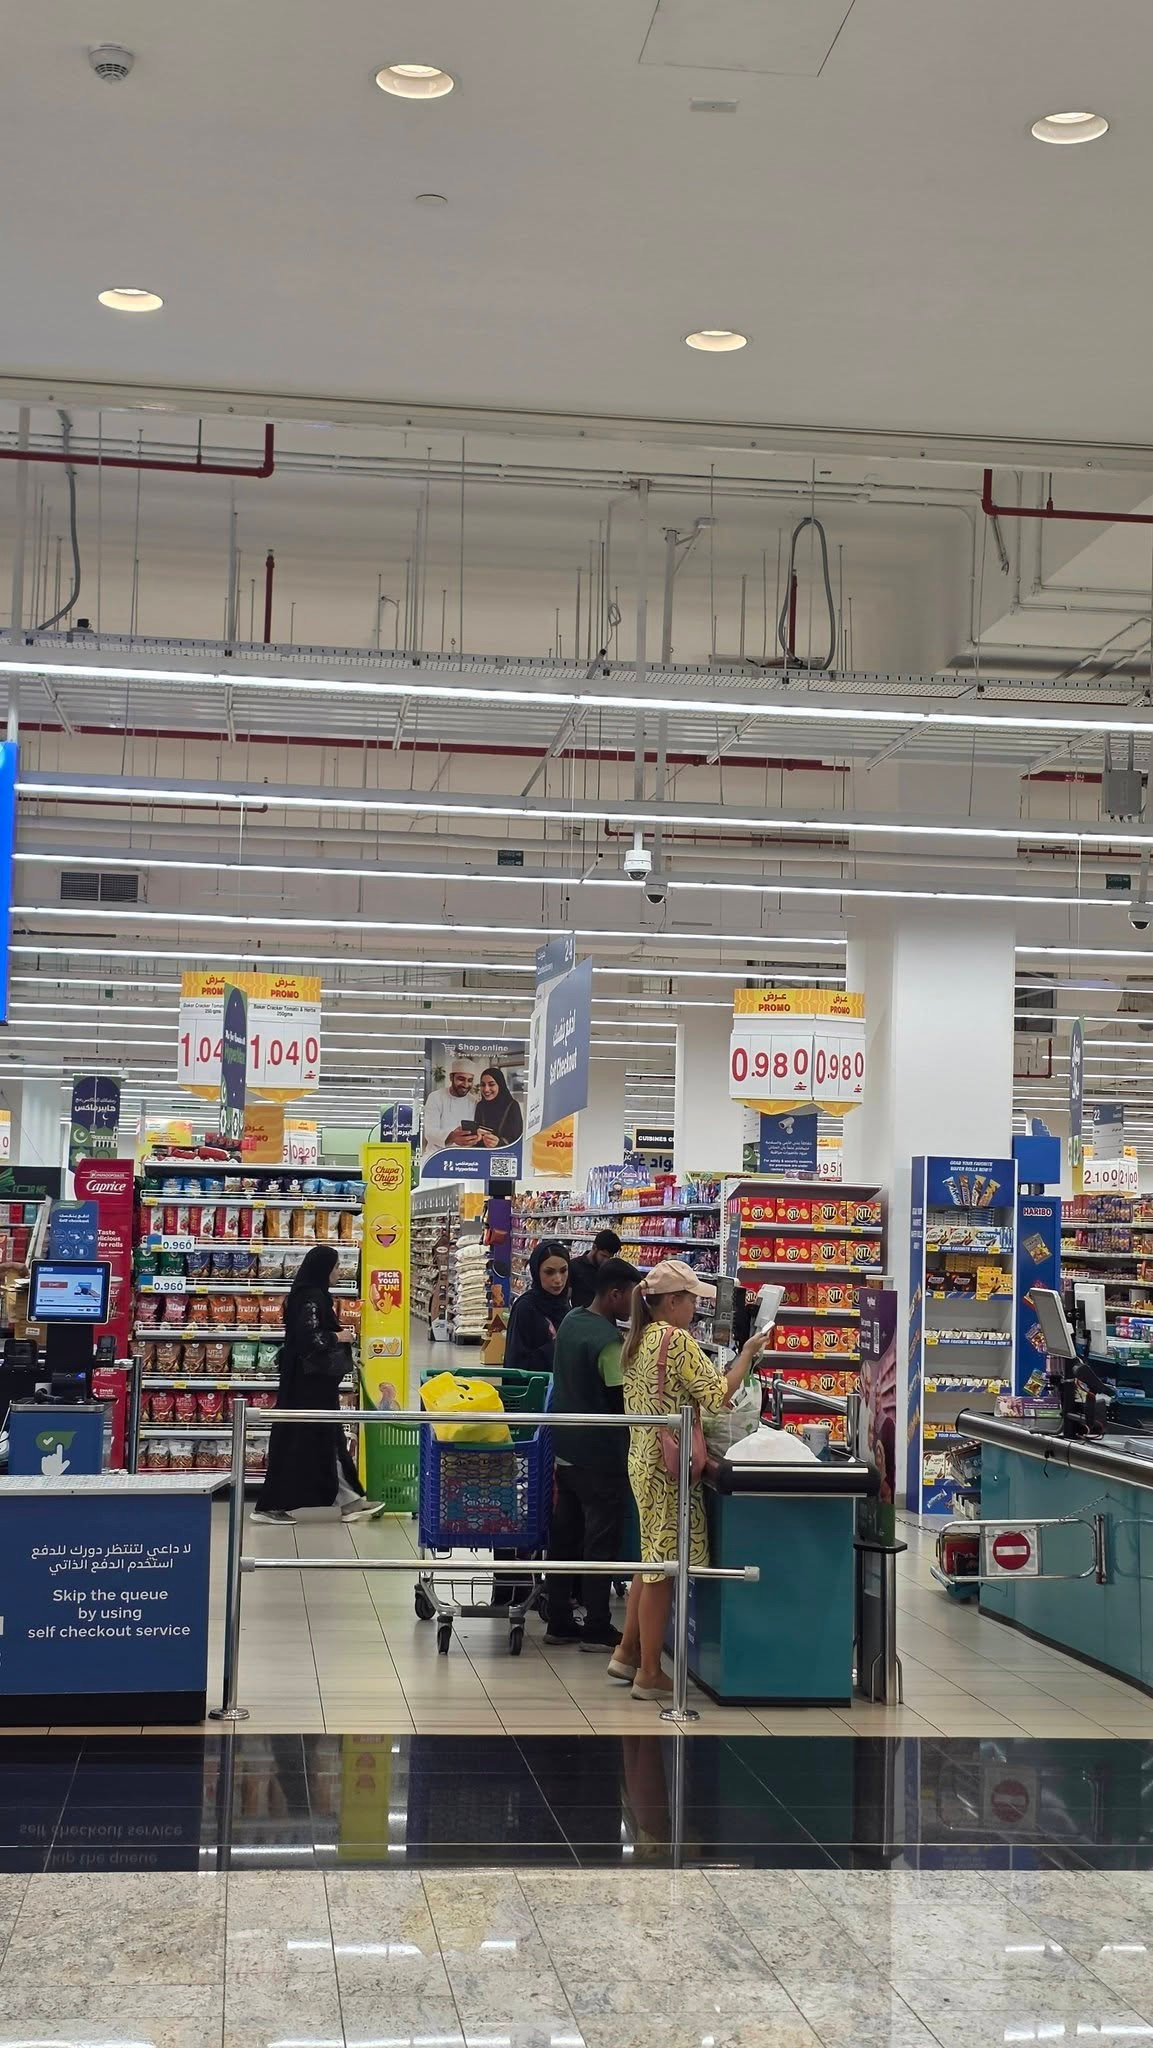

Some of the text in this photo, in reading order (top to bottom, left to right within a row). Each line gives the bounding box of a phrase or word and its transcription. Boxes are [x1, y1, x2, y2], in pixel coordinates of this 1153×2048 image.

[206, 975, 225, 984] عرض
[275, 977, 296, 988] عرض
[202, 987, 224, 995] PROM
[271, 990, 299, 998] PROMO
[763, 992, 786, 1001] عرض
[833, 994, 848, 1003] عرض
[830, 1006, 850, 1014] PROMO
[250, 1034, 318, 1069] 1.040
[458, 1043, 508, 1052] Shop online
[732, 1048, 808, 1081] 0.980
[816, 1050, 864, 1084] 0.980
[376, 1165, 400, 1176] Chupa
[374, 1173, 398, 1185] Chups
[86, 1180, 126, 1192] Caprice
[752, 1208, 764, 1218] RITZ
[788, 1209, 799, 1219] RITZ
[821, 1206, 836, 1219] RITZ
[856, 1206, 871, 1220] RITZ
[1024, 1207, 1052, 1217] HARIBO
[163, 1241, 192, 1250] 0.960
[750, 1248, 761, 1258] RITZ
[788, 1249, 799, 1259] RITZ
[821, 1245, 836, 1258] RITZ
[855, 1246, 871, 1259] RITZ
[378, 1271, 400, 1279] PICK
[154, 1282, 183, 1290] 0.960
[378, 1284, 400, 1292] FUN!
[828, 1289, 843, 1302] RITZ
[788, 1335, 799, 1347] RITZ
[824, 1332, 838, 1346] RITZ
[821, 1376, 835, 1390] RITZ
[31, 1544, 191, 1559] لا داعي لتنتظر دورك للدفع
[49, 1558, 173, 1575] استخدم الدفع الذاتي
[53, 1589, 168, 1603] Skip the queue
[78, 1607, 142, 1622] by using
[28, 1624, 191, 1638] self checkout service
